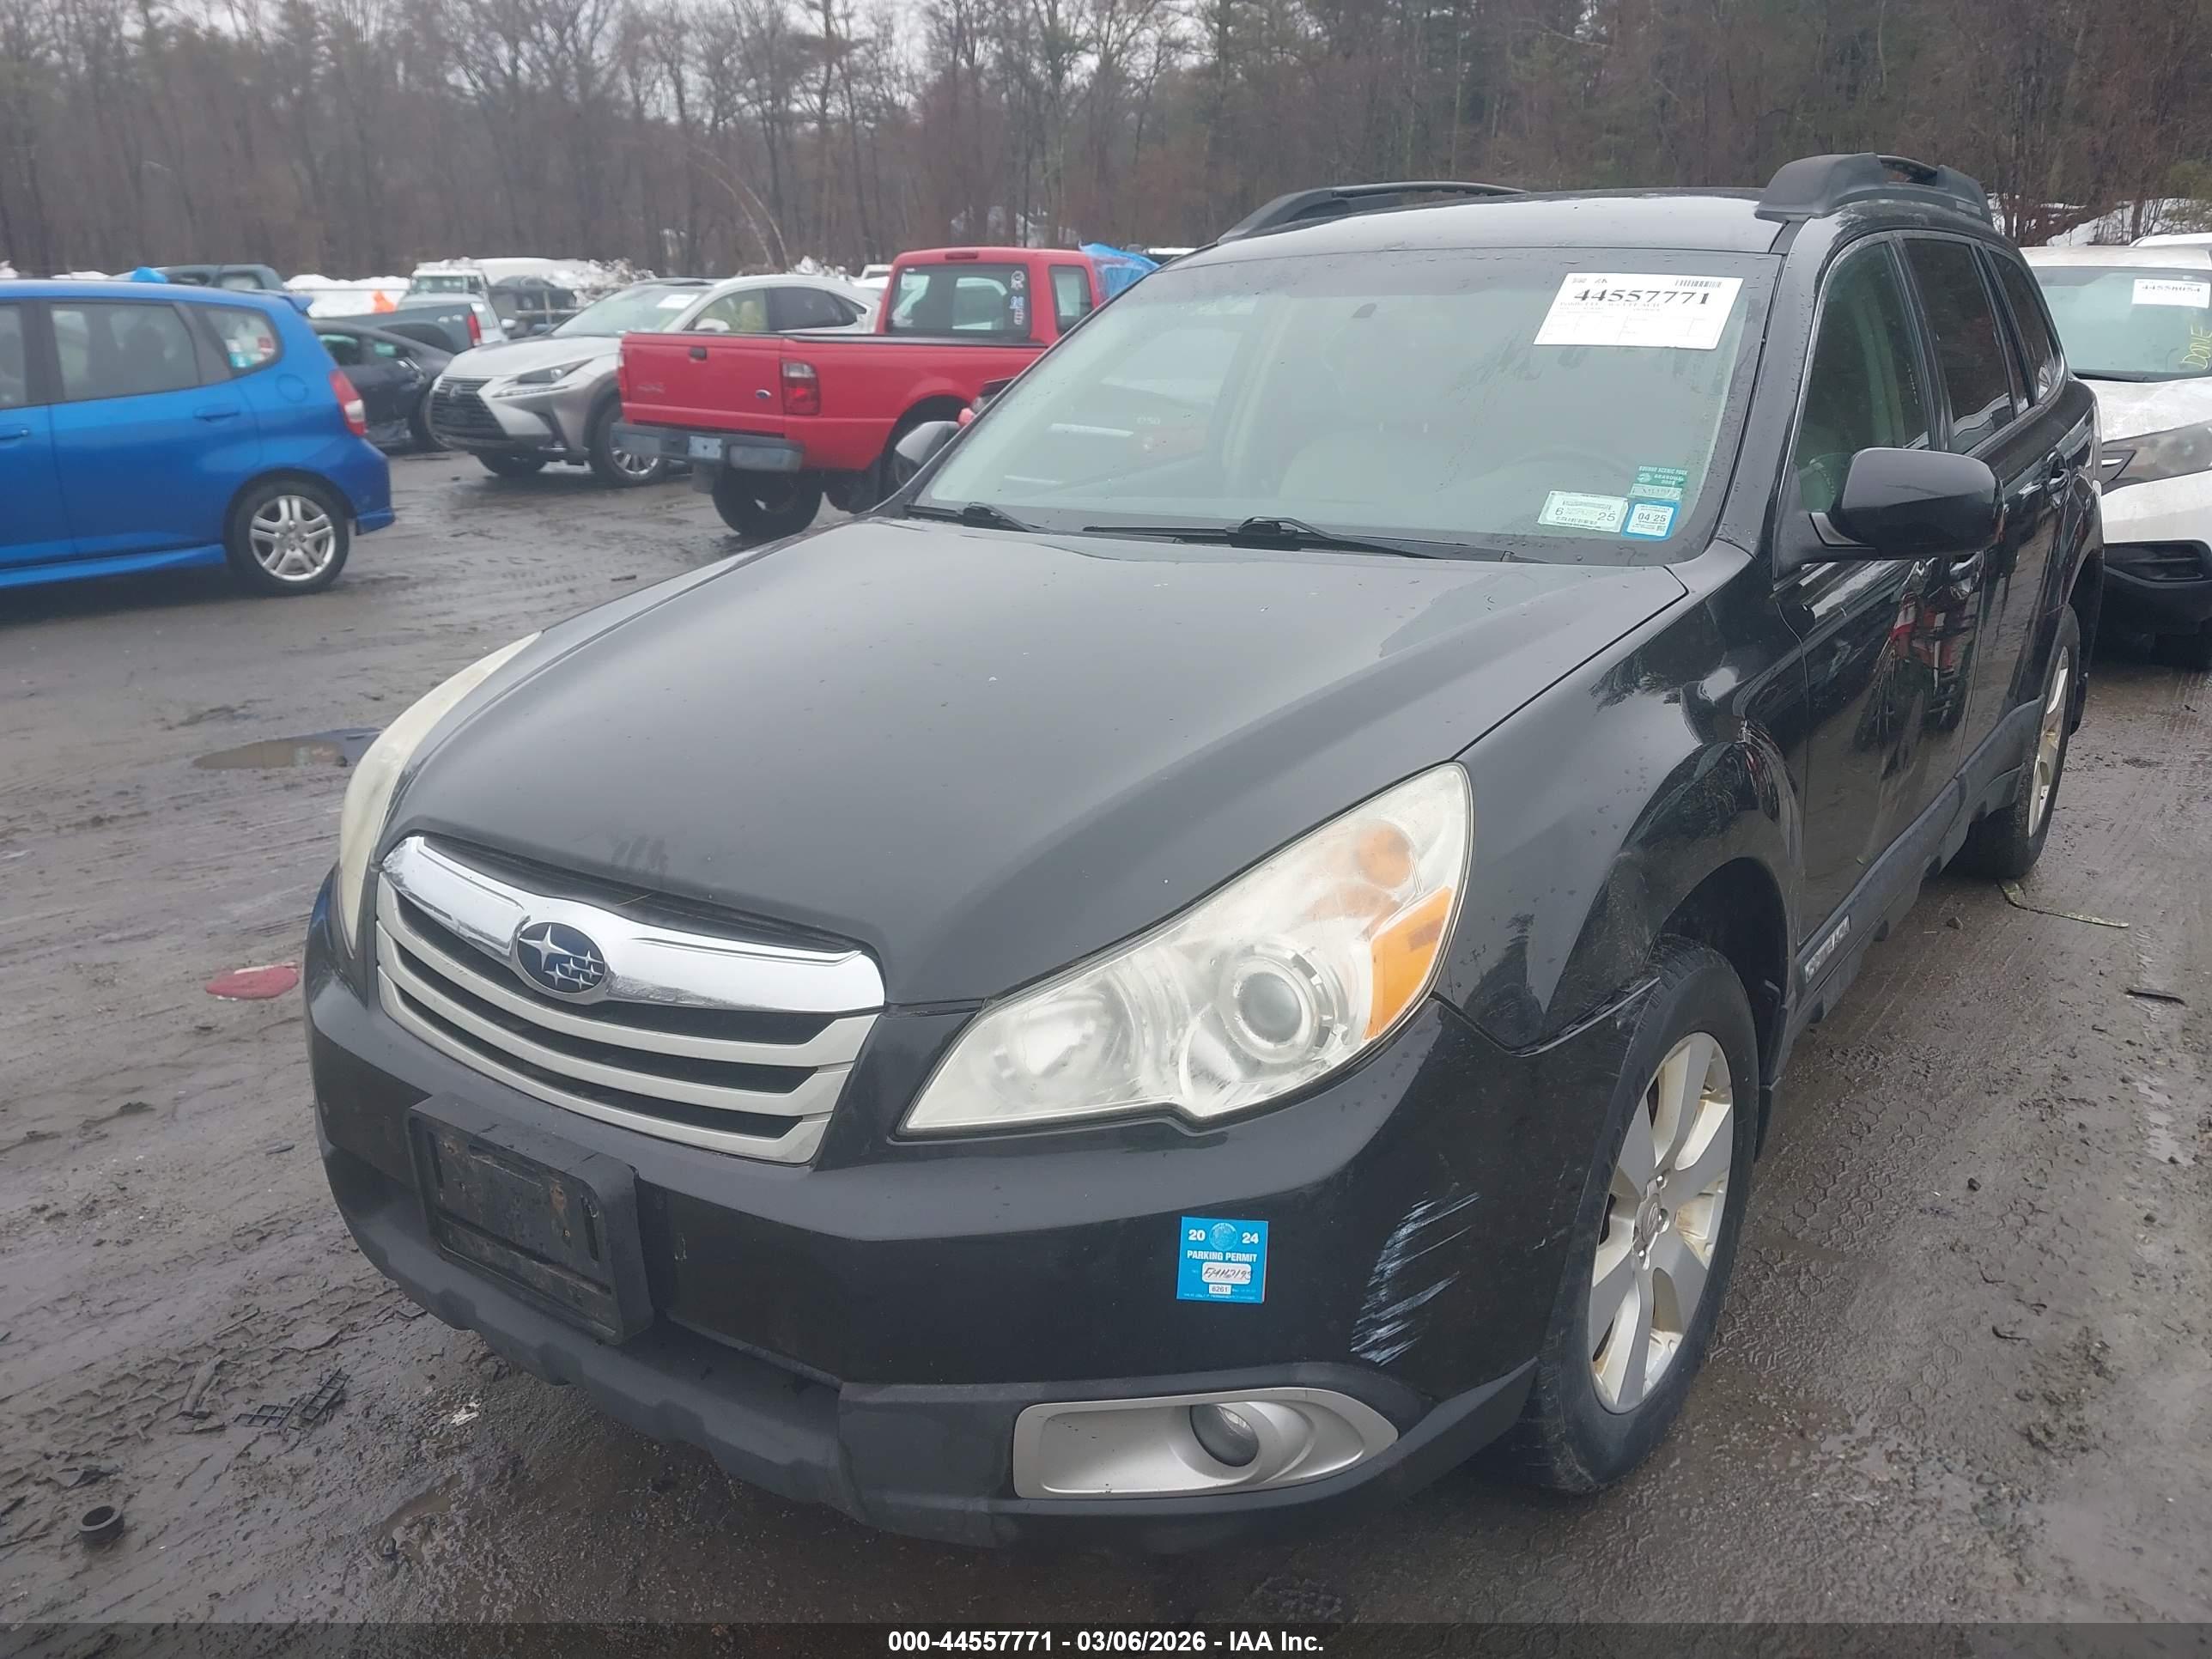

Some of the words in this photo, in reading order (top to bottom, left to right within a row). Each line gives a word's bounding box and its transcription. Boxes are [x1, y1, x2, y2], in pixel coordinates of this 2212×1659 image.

[1573, 289, 1711, 305] 44557771
[2180, 325, 2212, 369] DONE
[1597, 512, 1616, 522] 25
[1638, 513, 1650, 521] 04
[1653, 514, 1667, 523] 25
[1188, 1229, 1206, 1242] 20
[1242, 1232, 1259, 1244] 24
[1187, 1249, 1224, 1261] PARKING
[1225, 1252, 1258, 1262] PERMIT
